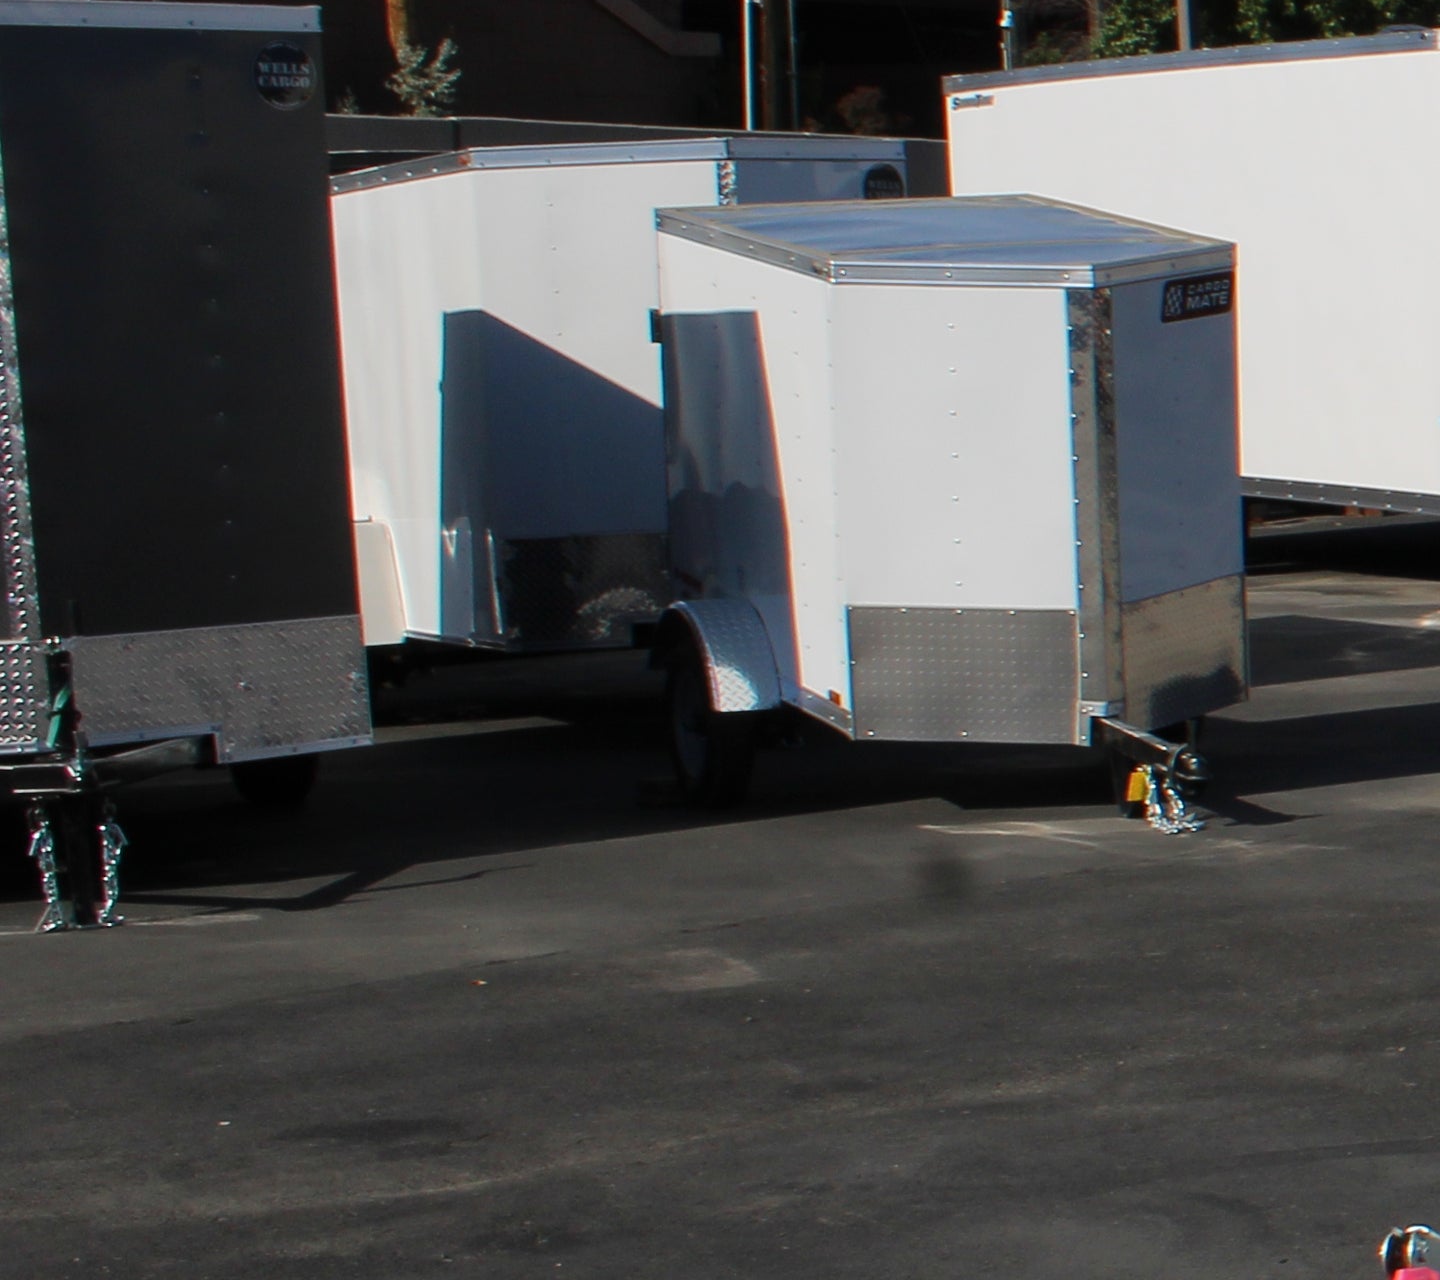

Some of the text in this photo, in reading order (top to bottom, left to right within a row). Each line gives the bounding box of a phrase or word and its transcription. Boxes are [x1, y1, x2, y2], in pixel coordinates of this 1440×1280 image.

[258, 62, 310, 74] WELLS
[258, 75, 310, 88] CARGO
[1187, 279, 1230, 295] CARGO
[1187, 291, 1229, 310] MATE
